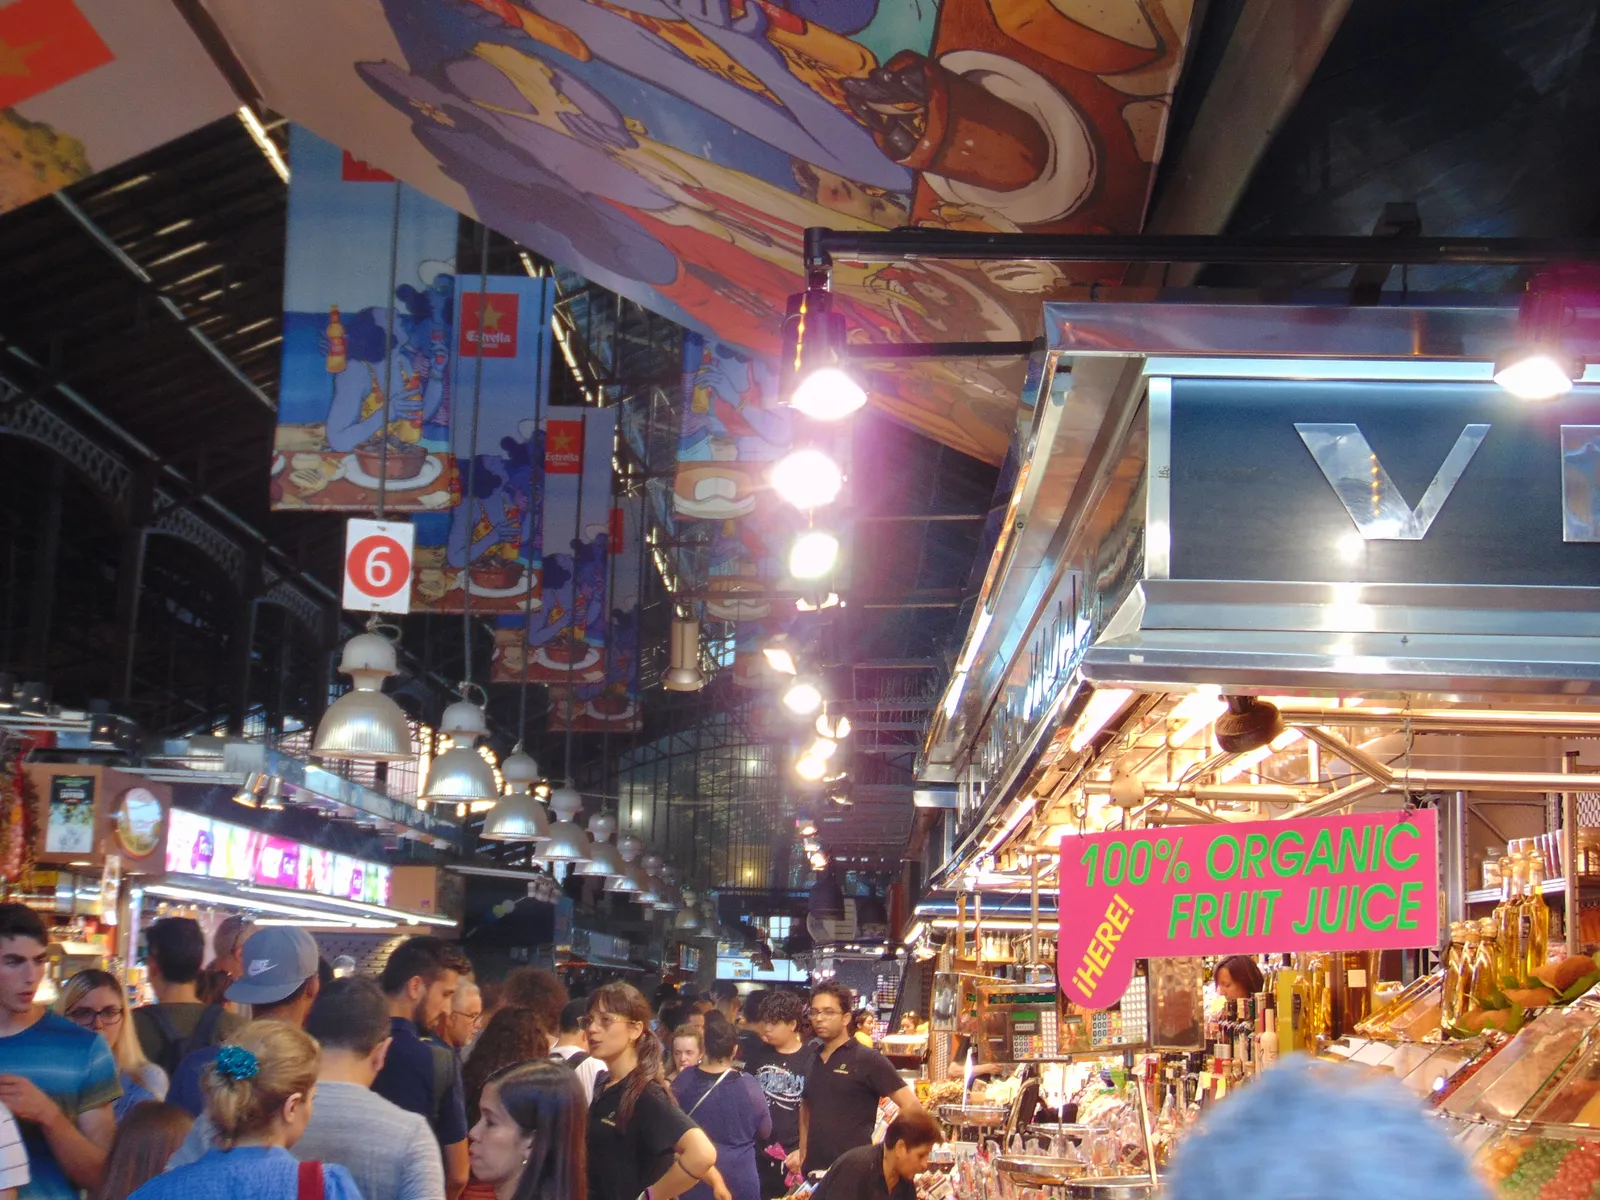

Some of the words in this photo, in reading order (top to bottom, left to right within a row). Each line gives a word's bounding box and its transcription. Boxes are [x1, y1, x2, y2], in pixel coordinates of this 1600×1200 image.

[364, 546, 393, 588] 6
[1081, 837, 1191, 887] 100%
[1206, 823, 1421, 880] ORGANIC
[1167, 889, 1282, 940] FRUIT
[1292, 881, 1423, 935] JUICE
[1071, 893, 1136, 999] ¡HERE!
